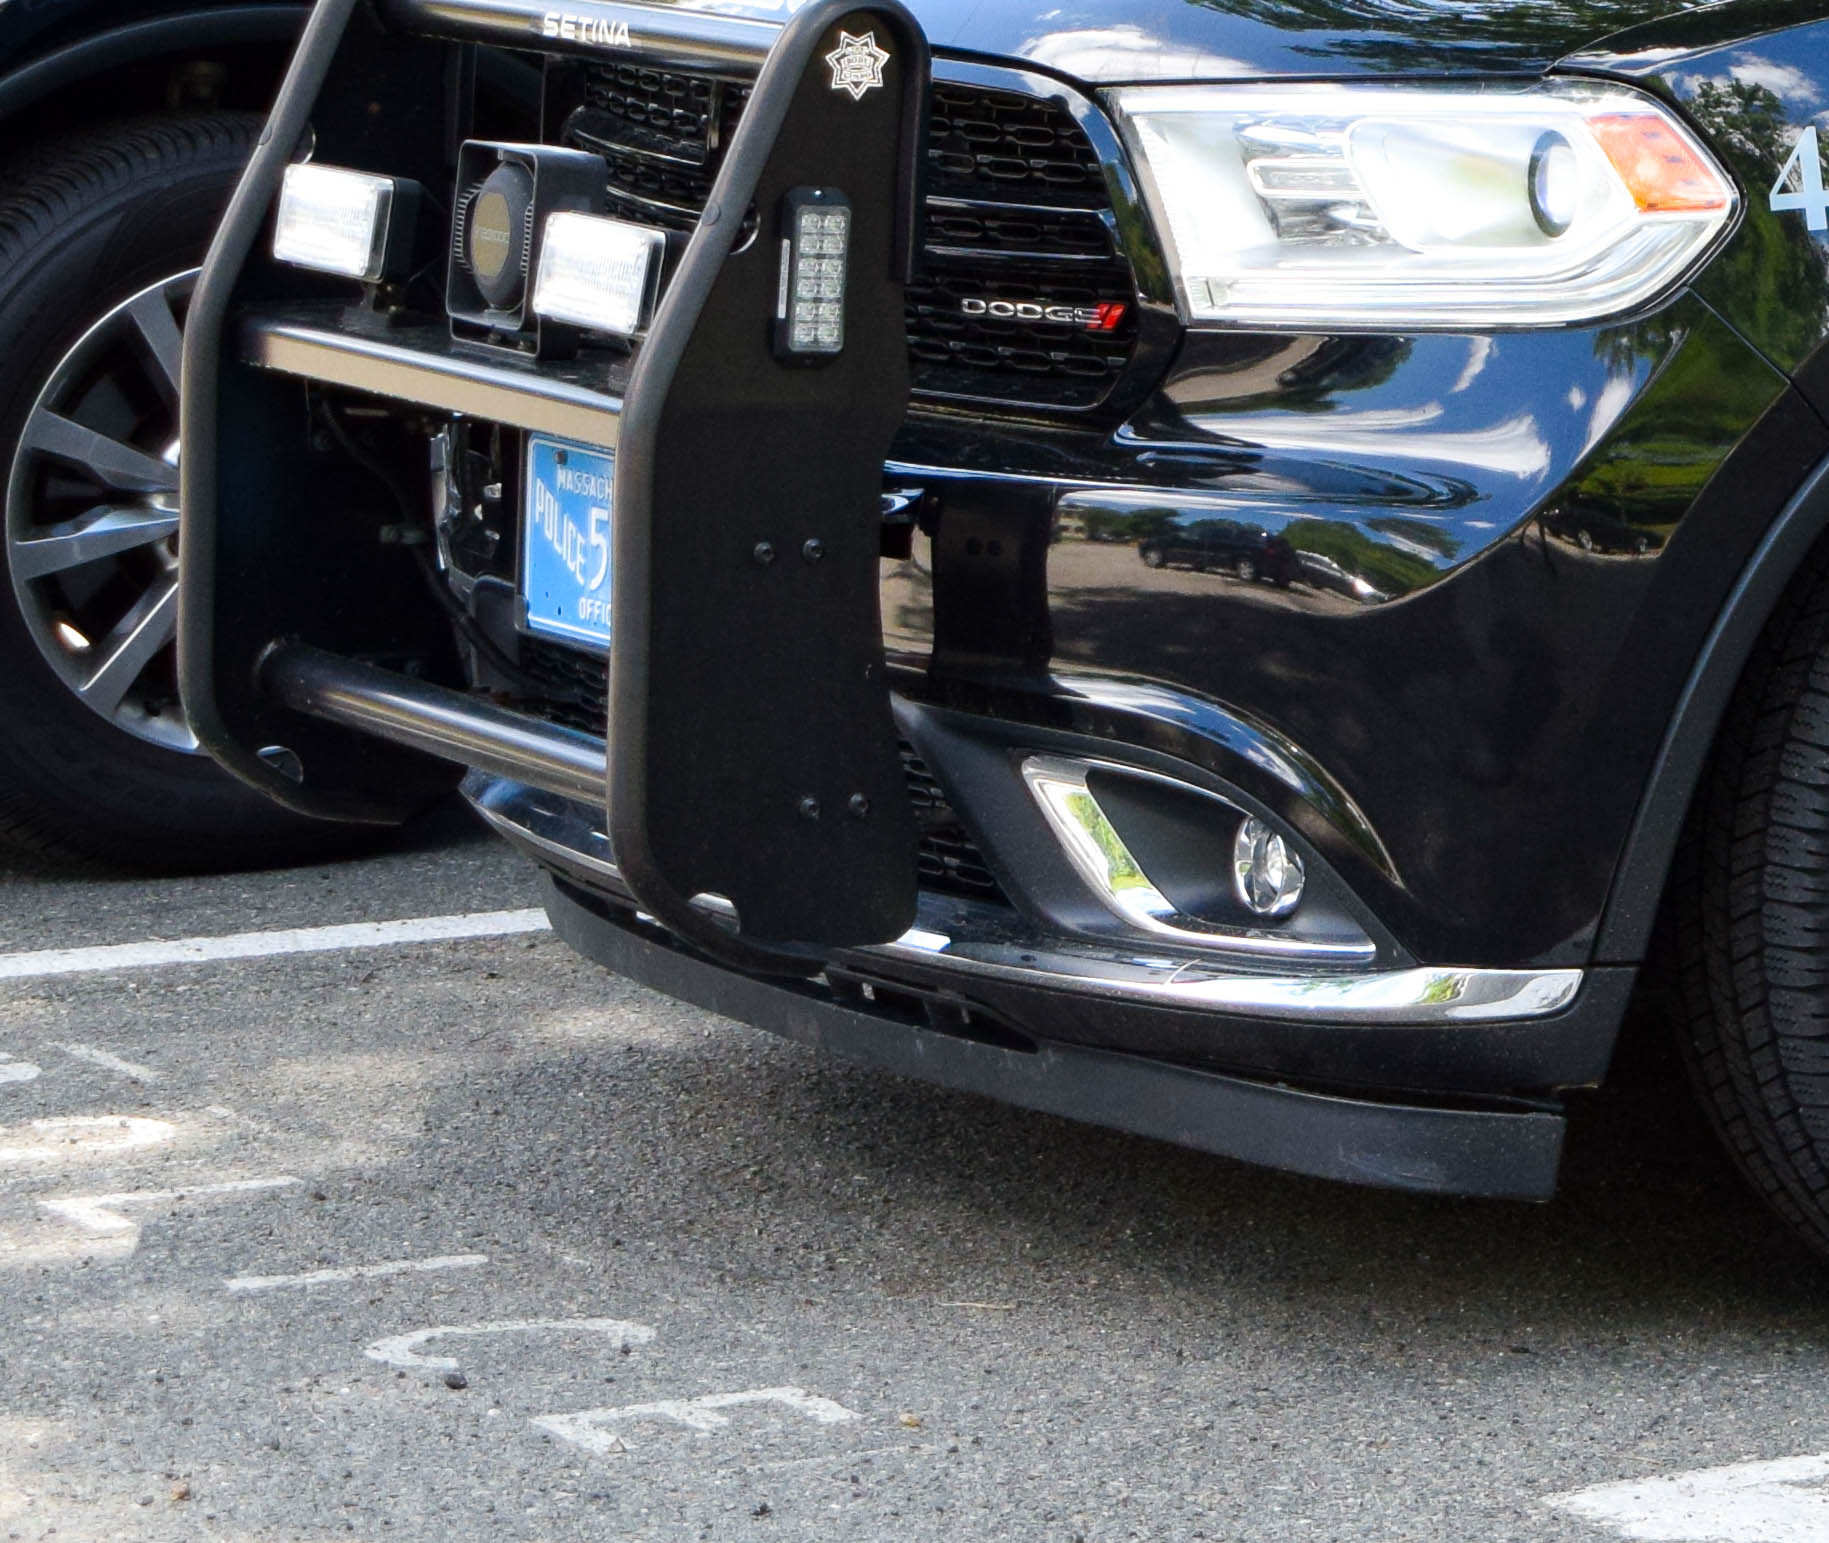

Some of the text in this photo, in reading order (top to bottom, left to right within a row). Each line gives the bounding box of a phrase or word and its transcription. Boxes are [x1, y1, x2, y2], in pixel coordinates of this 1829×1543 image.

[542, 12, 633, 47] SETINA
[961, 298, 1102, 325] DODGE
[535, 478, 585, 587] POLICE
